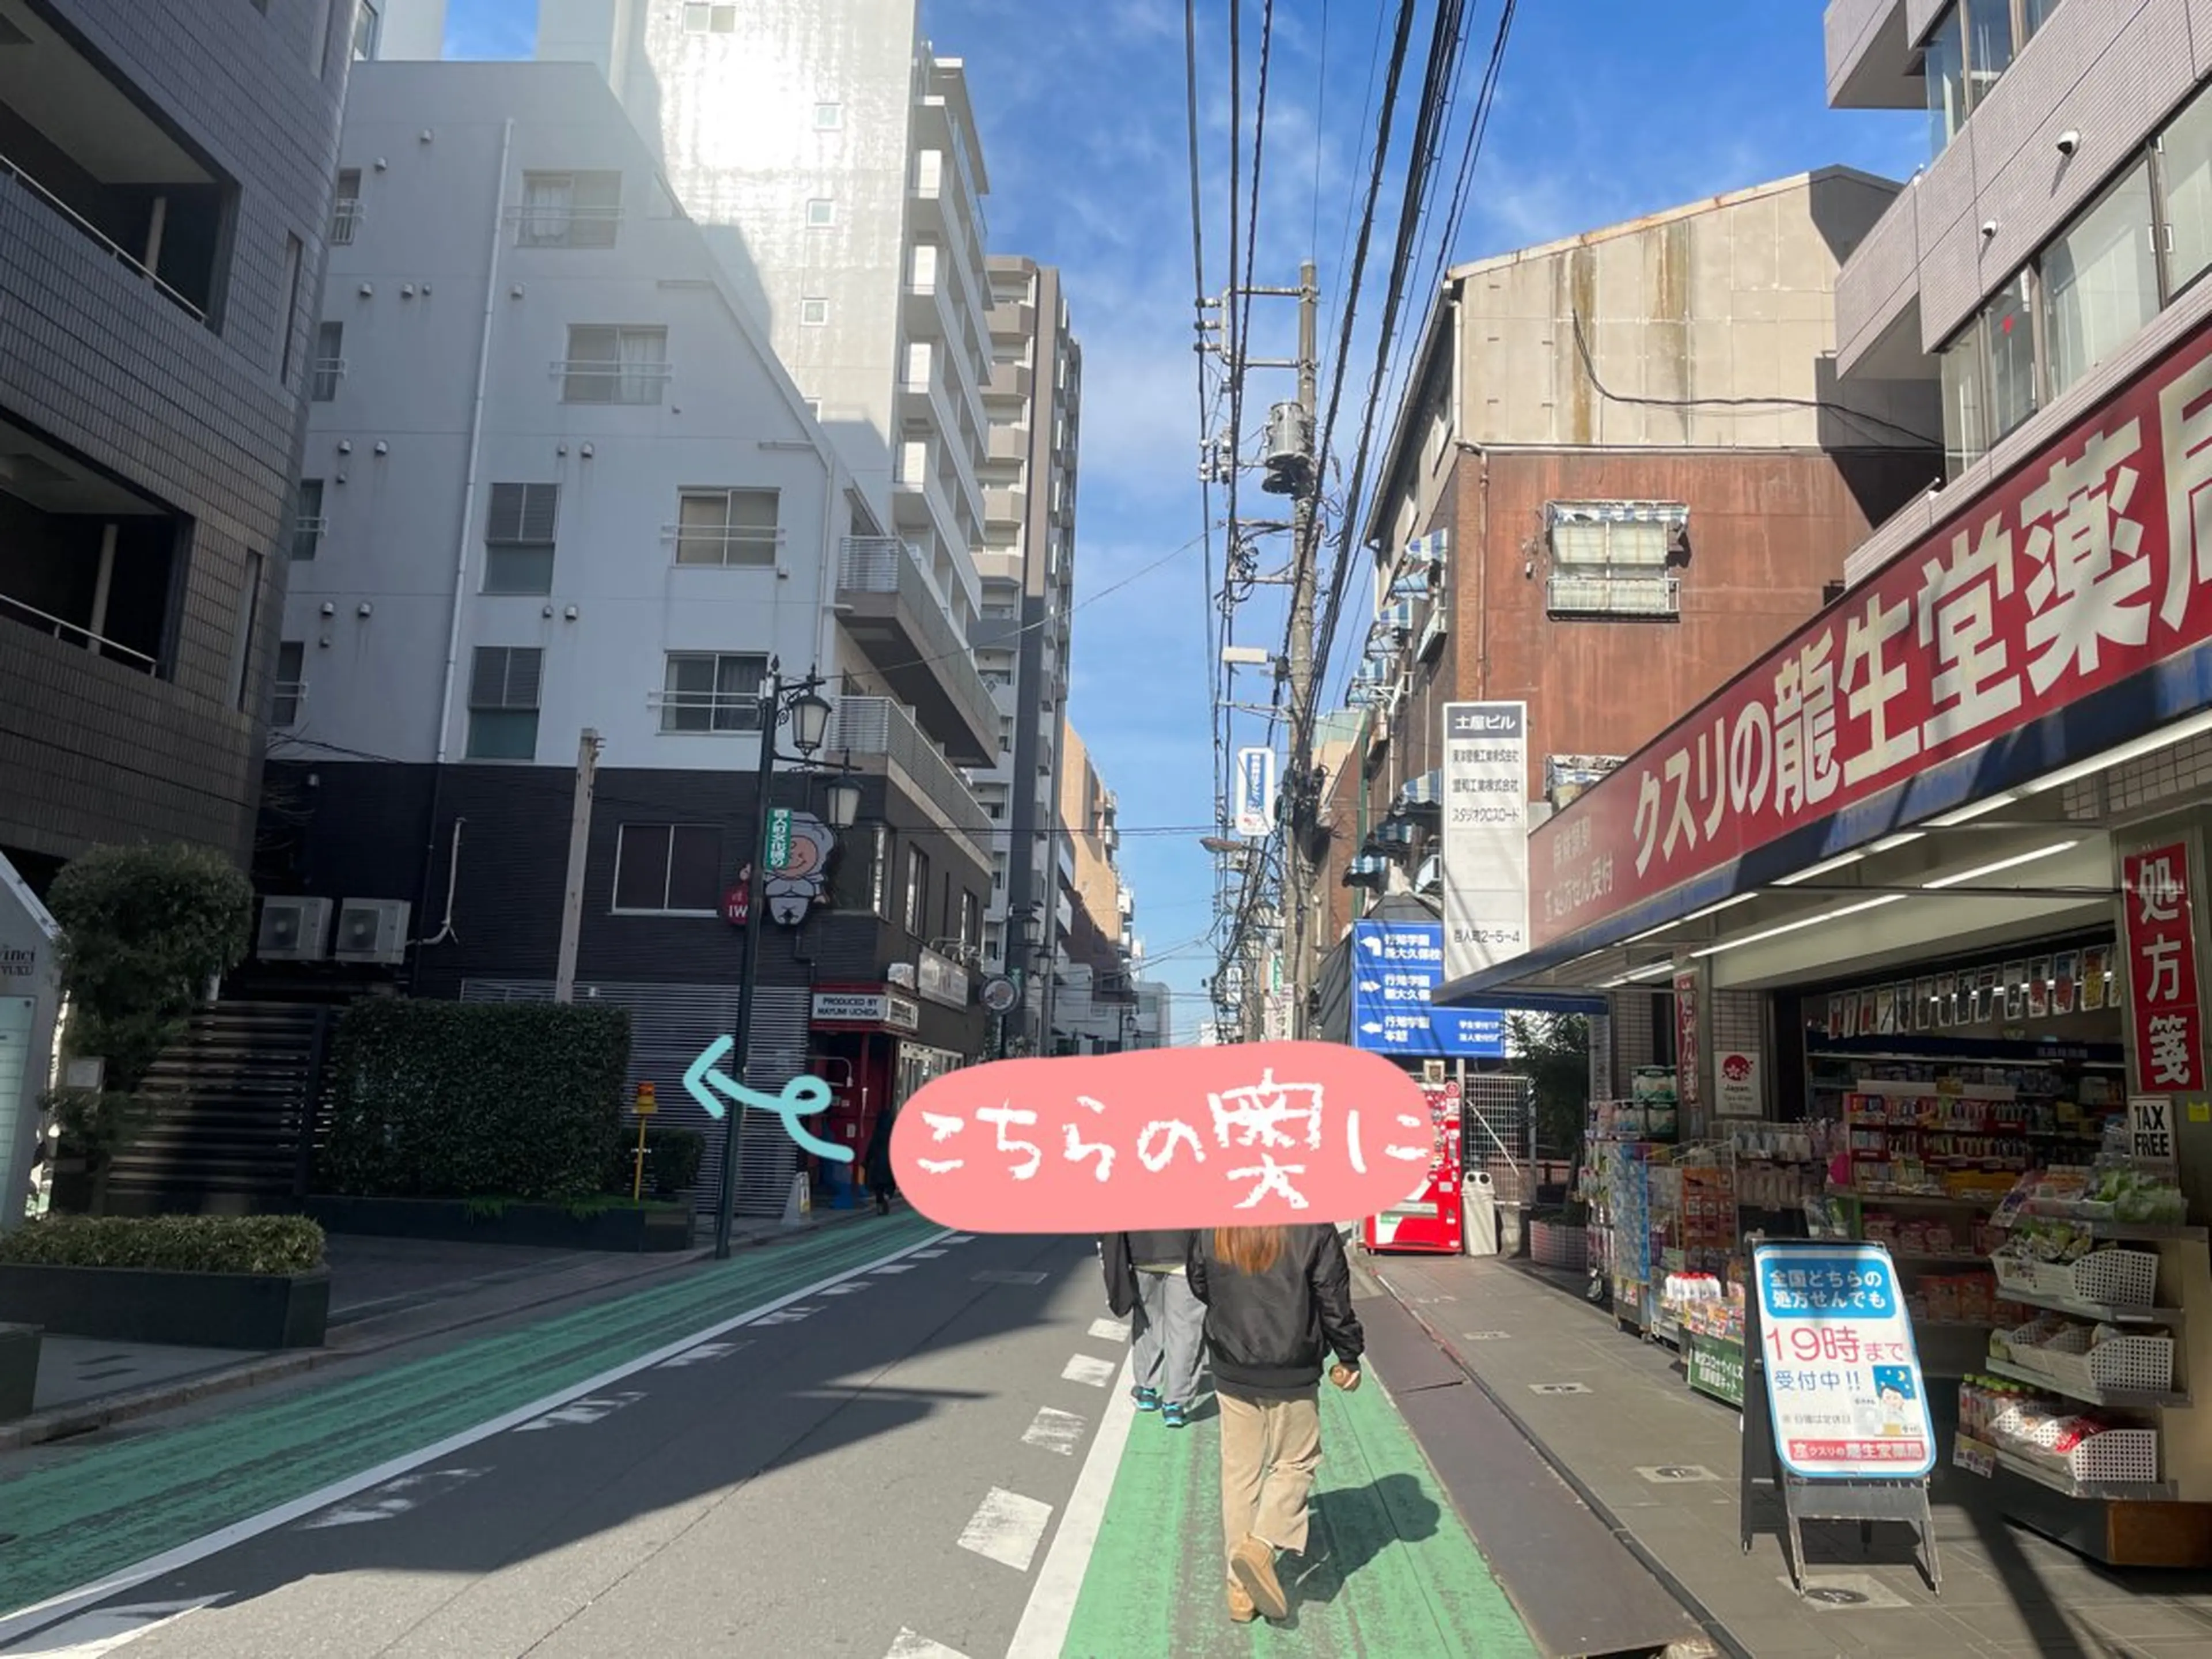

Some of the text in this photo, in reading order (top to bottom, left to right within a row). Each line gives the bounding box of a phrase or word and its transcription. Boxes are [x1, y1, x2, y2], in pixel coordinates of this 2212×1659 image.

[1455, 715, 1516, 730] 土屋ビル
[0, 944, 35, 963] inci
[2138, 855, 2190, 1085] 処方箋
[867, 998, 878, 1006] BY
[2134, 1105, 2165, 1130] TAX
[2134, 1132, 2170, 1157] FREE
[1770, 1269, 1883, 1288] 全国どちらの
[1772, 1290, 1887, 1309] 処方せんでも
